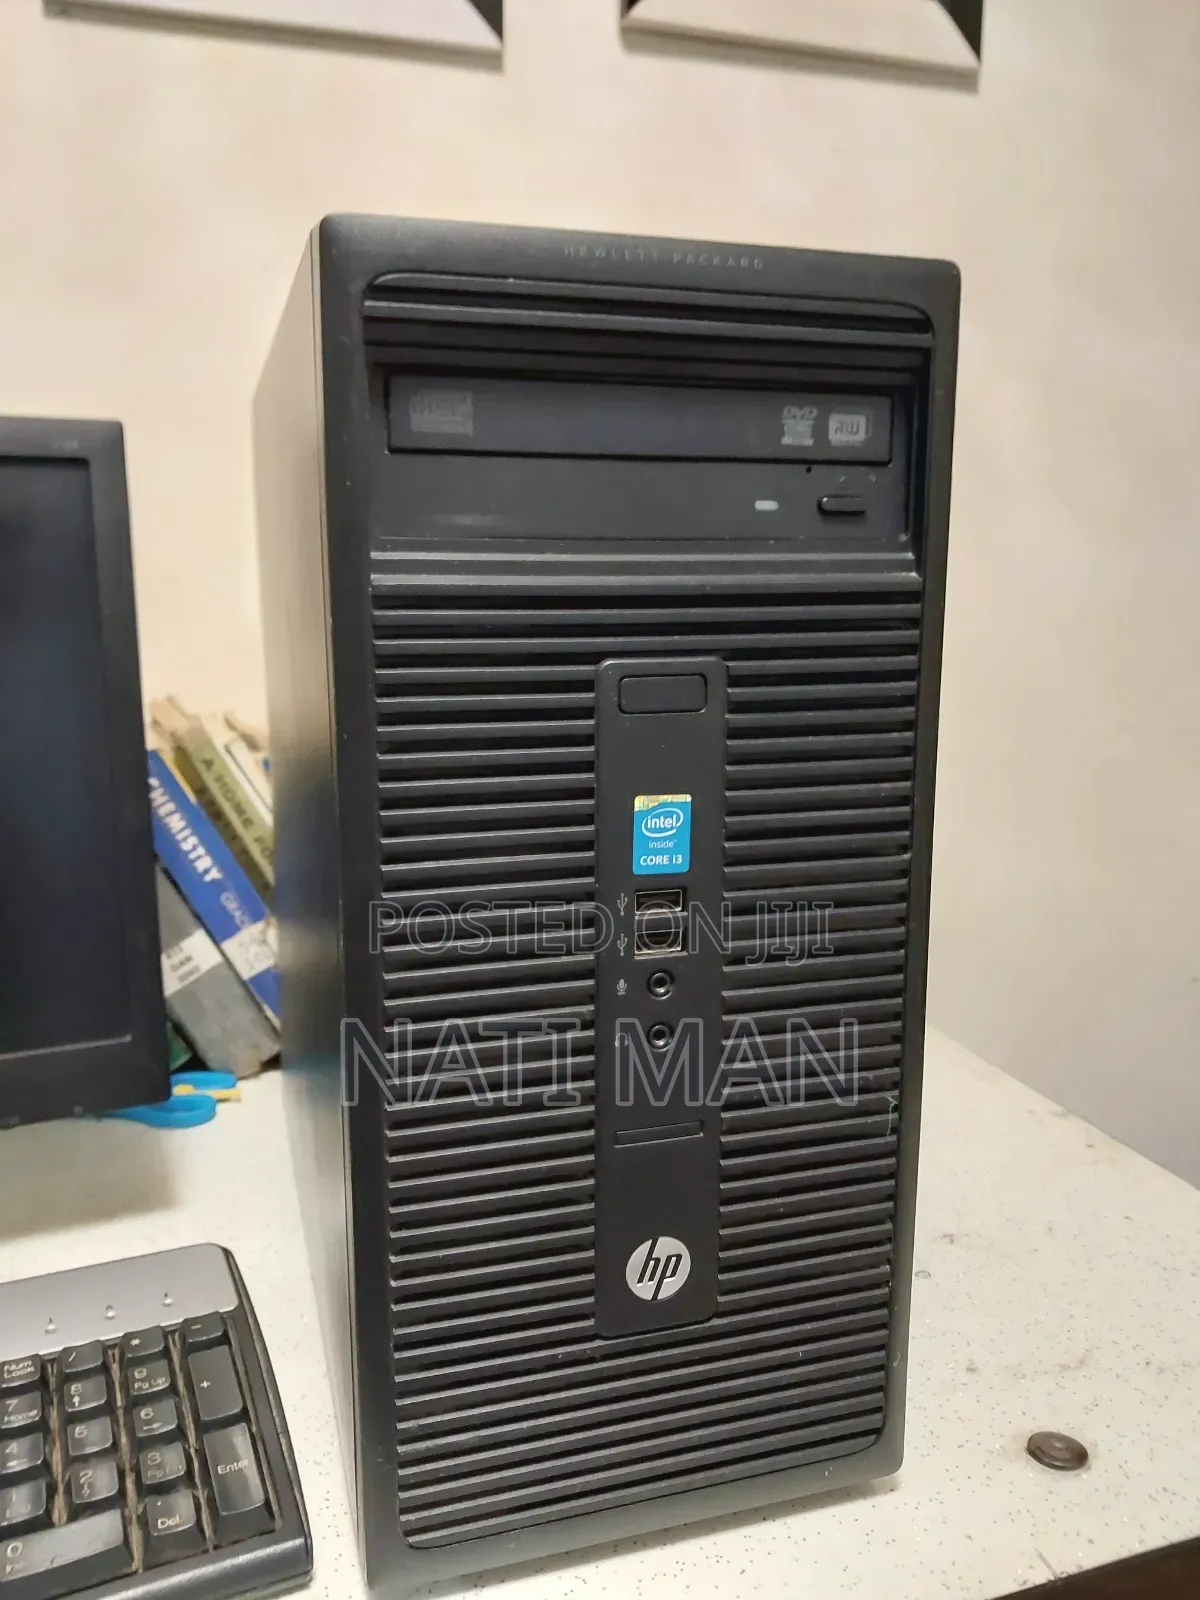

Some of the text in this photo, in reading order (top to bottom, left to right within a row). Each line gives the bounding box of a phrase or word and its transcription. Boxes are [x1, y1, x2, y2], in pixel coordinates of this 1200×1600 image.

[647, 814, 677, 829] intel
[648, 839, 675, 849] inside
[640, 854, 670, 866] CORE
[5, 1399, 19, 1412] 7
[140, 1407, 154, 1420] 6
[5, 1441, 18, 1454] 4
[147, 1452, 161, 1465] 3
[217, 1459, 249, 1475] Enter
[79, 1469, 93, 1484] 2
[157, 1514, 180, 1529] Del
